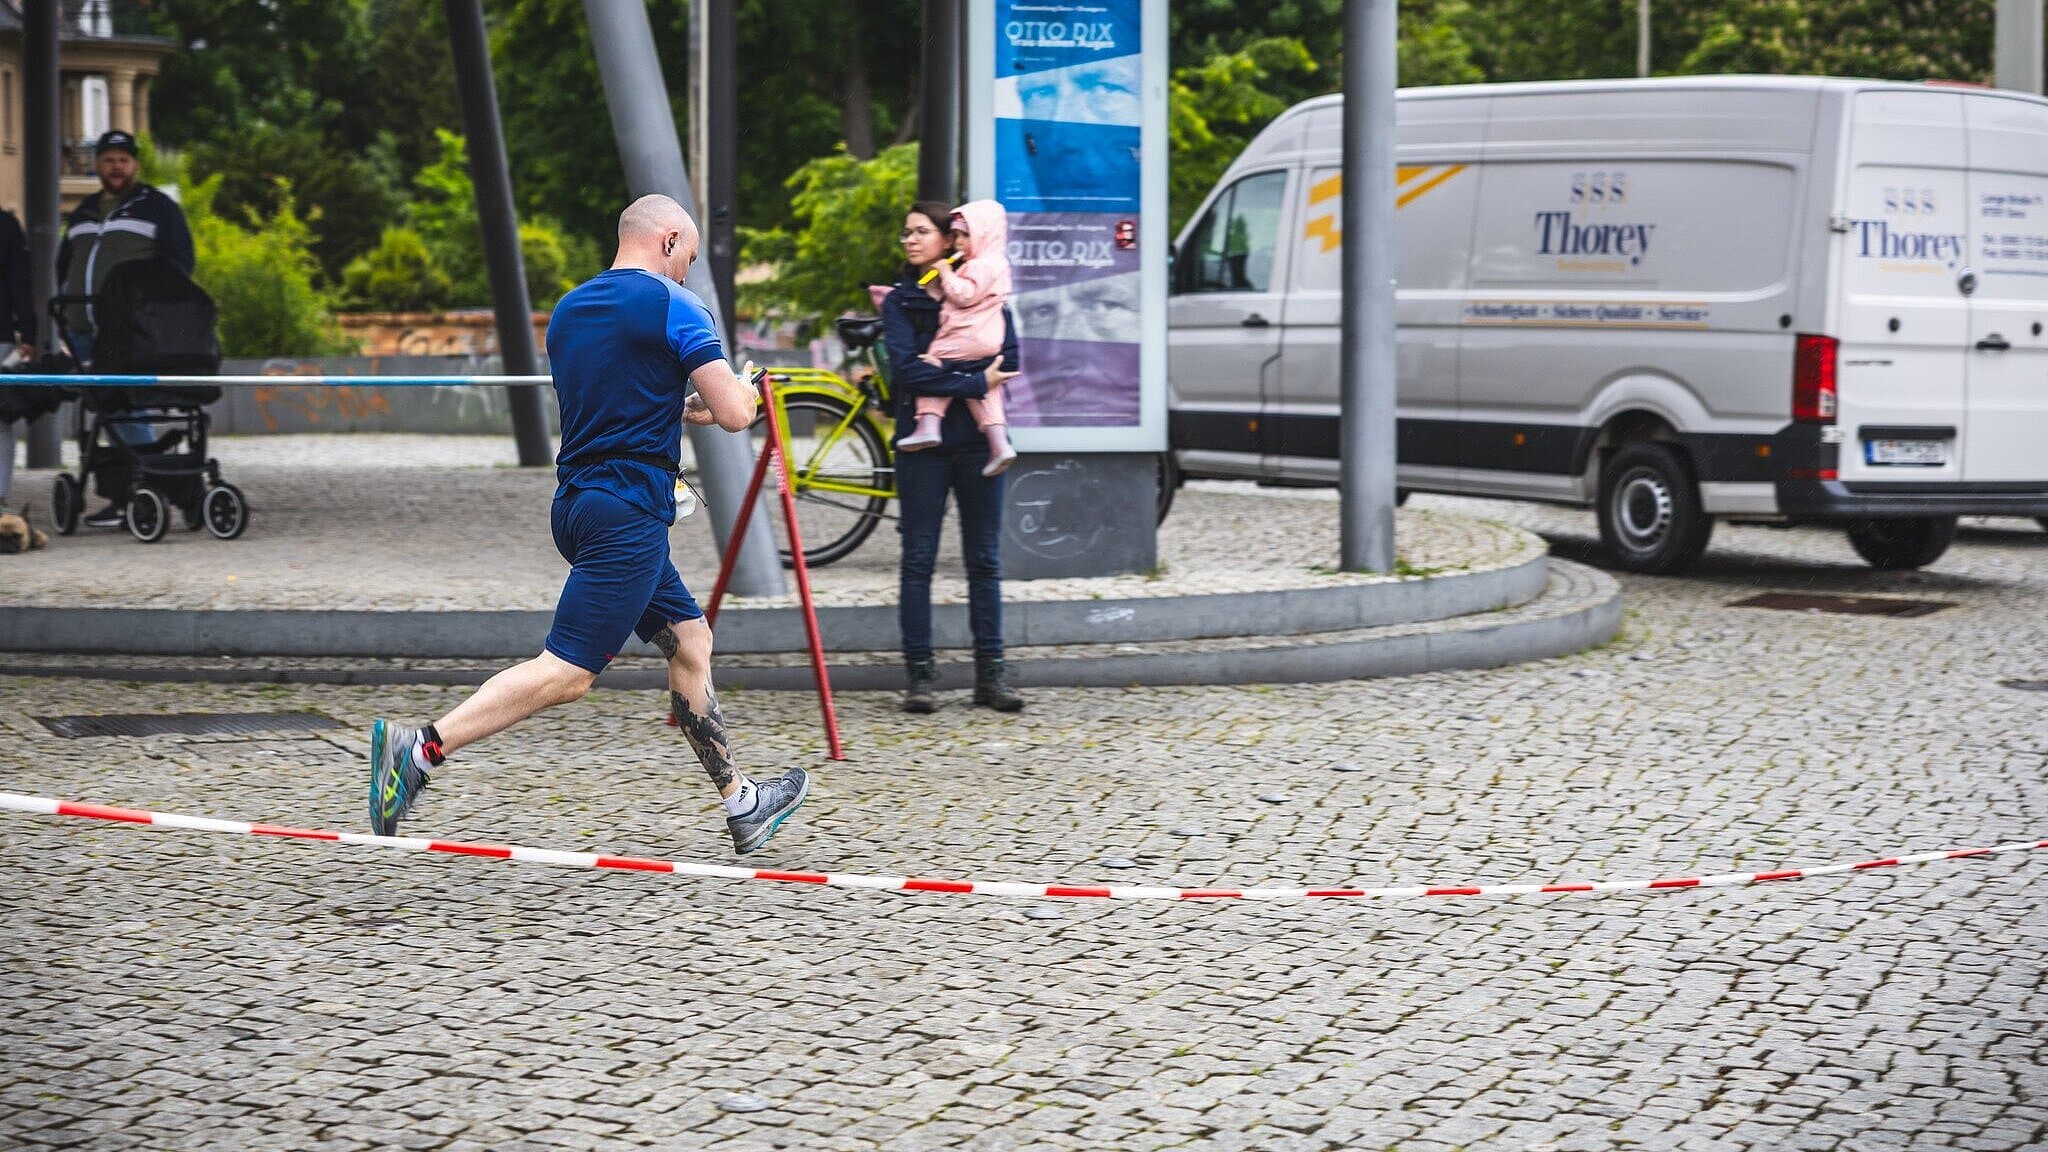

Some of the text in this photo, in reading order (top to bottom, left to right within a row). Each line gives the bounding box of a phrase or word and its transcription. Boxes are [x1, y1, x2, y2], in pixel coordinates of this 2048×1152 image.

[1005, 21, 1113, 41] OTTO DIX
[1007, 241, 1113, 260] OTTO DIX
[1534, 211, 1656, 266] Thorey
[1850, 220, 1967, 268] Thorey
